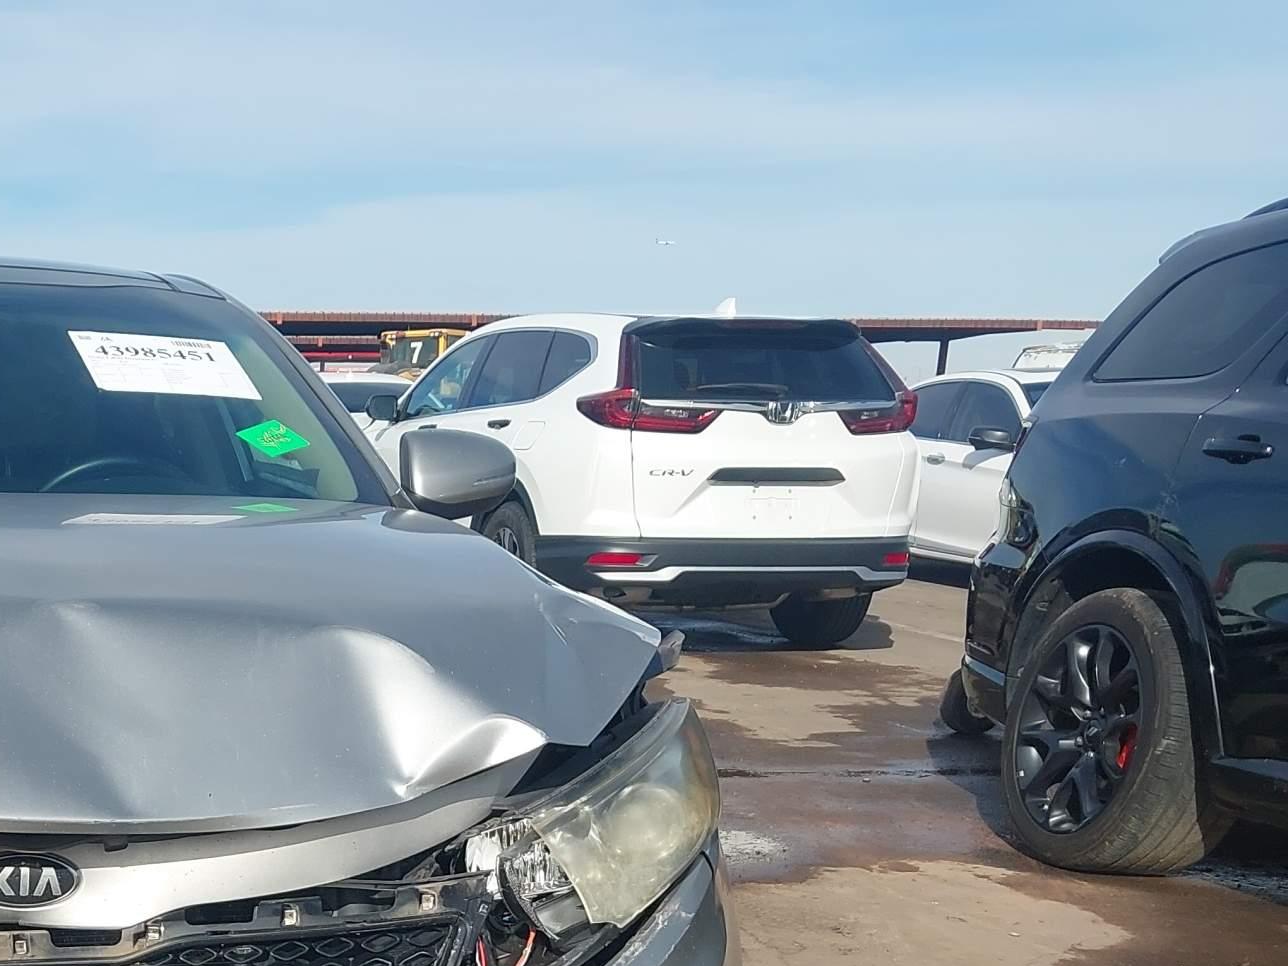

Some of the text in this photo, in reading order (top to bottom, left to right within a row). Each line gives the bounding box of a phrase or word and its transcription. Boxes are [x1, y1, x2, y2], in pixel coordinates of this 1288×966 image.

[94, 344, 216, 362] 43985451
[410, 341, 423, 364] 7
[649, 468, 694, 477] CR-V
